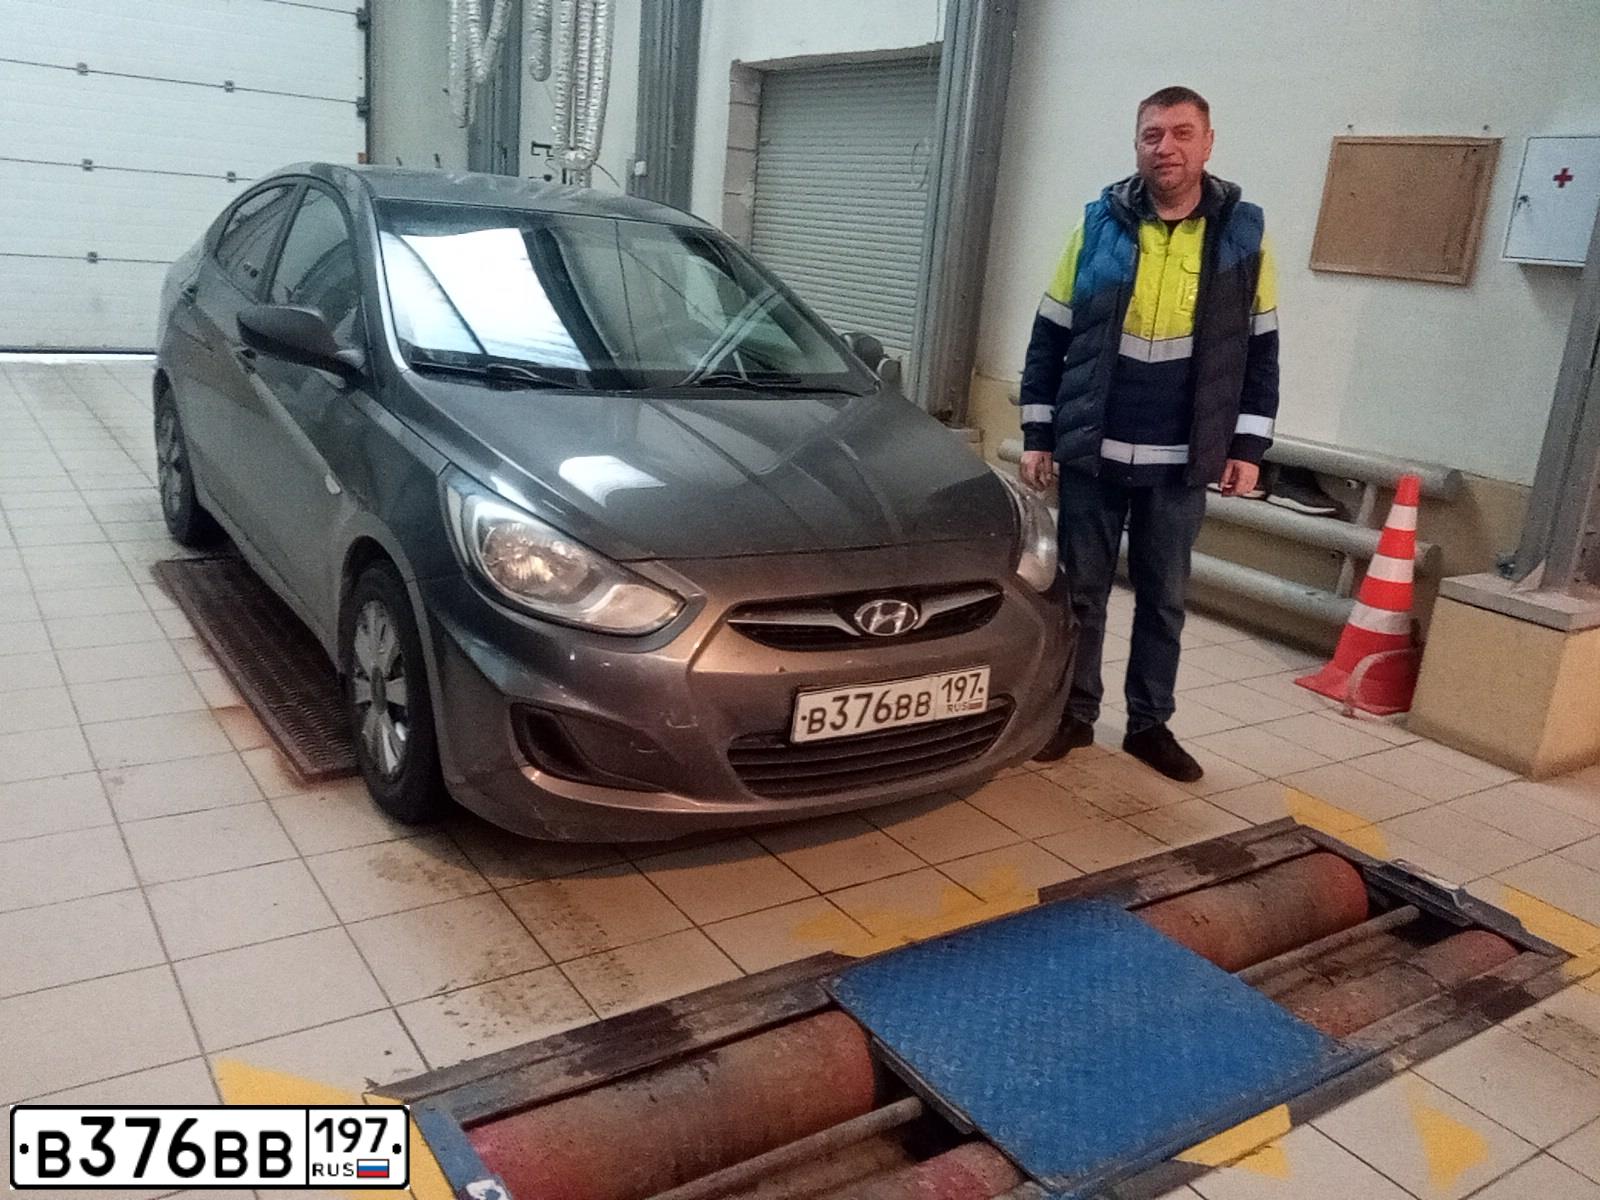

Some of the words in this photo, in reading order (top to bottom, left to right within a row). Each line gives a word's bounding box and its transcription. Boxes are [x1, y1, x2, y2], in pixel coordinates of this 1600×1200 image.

[807, 690, 931, 735] В376ВВ
[941, 672, 981, 703] 197
[946, 701, 968, 713] RUS
